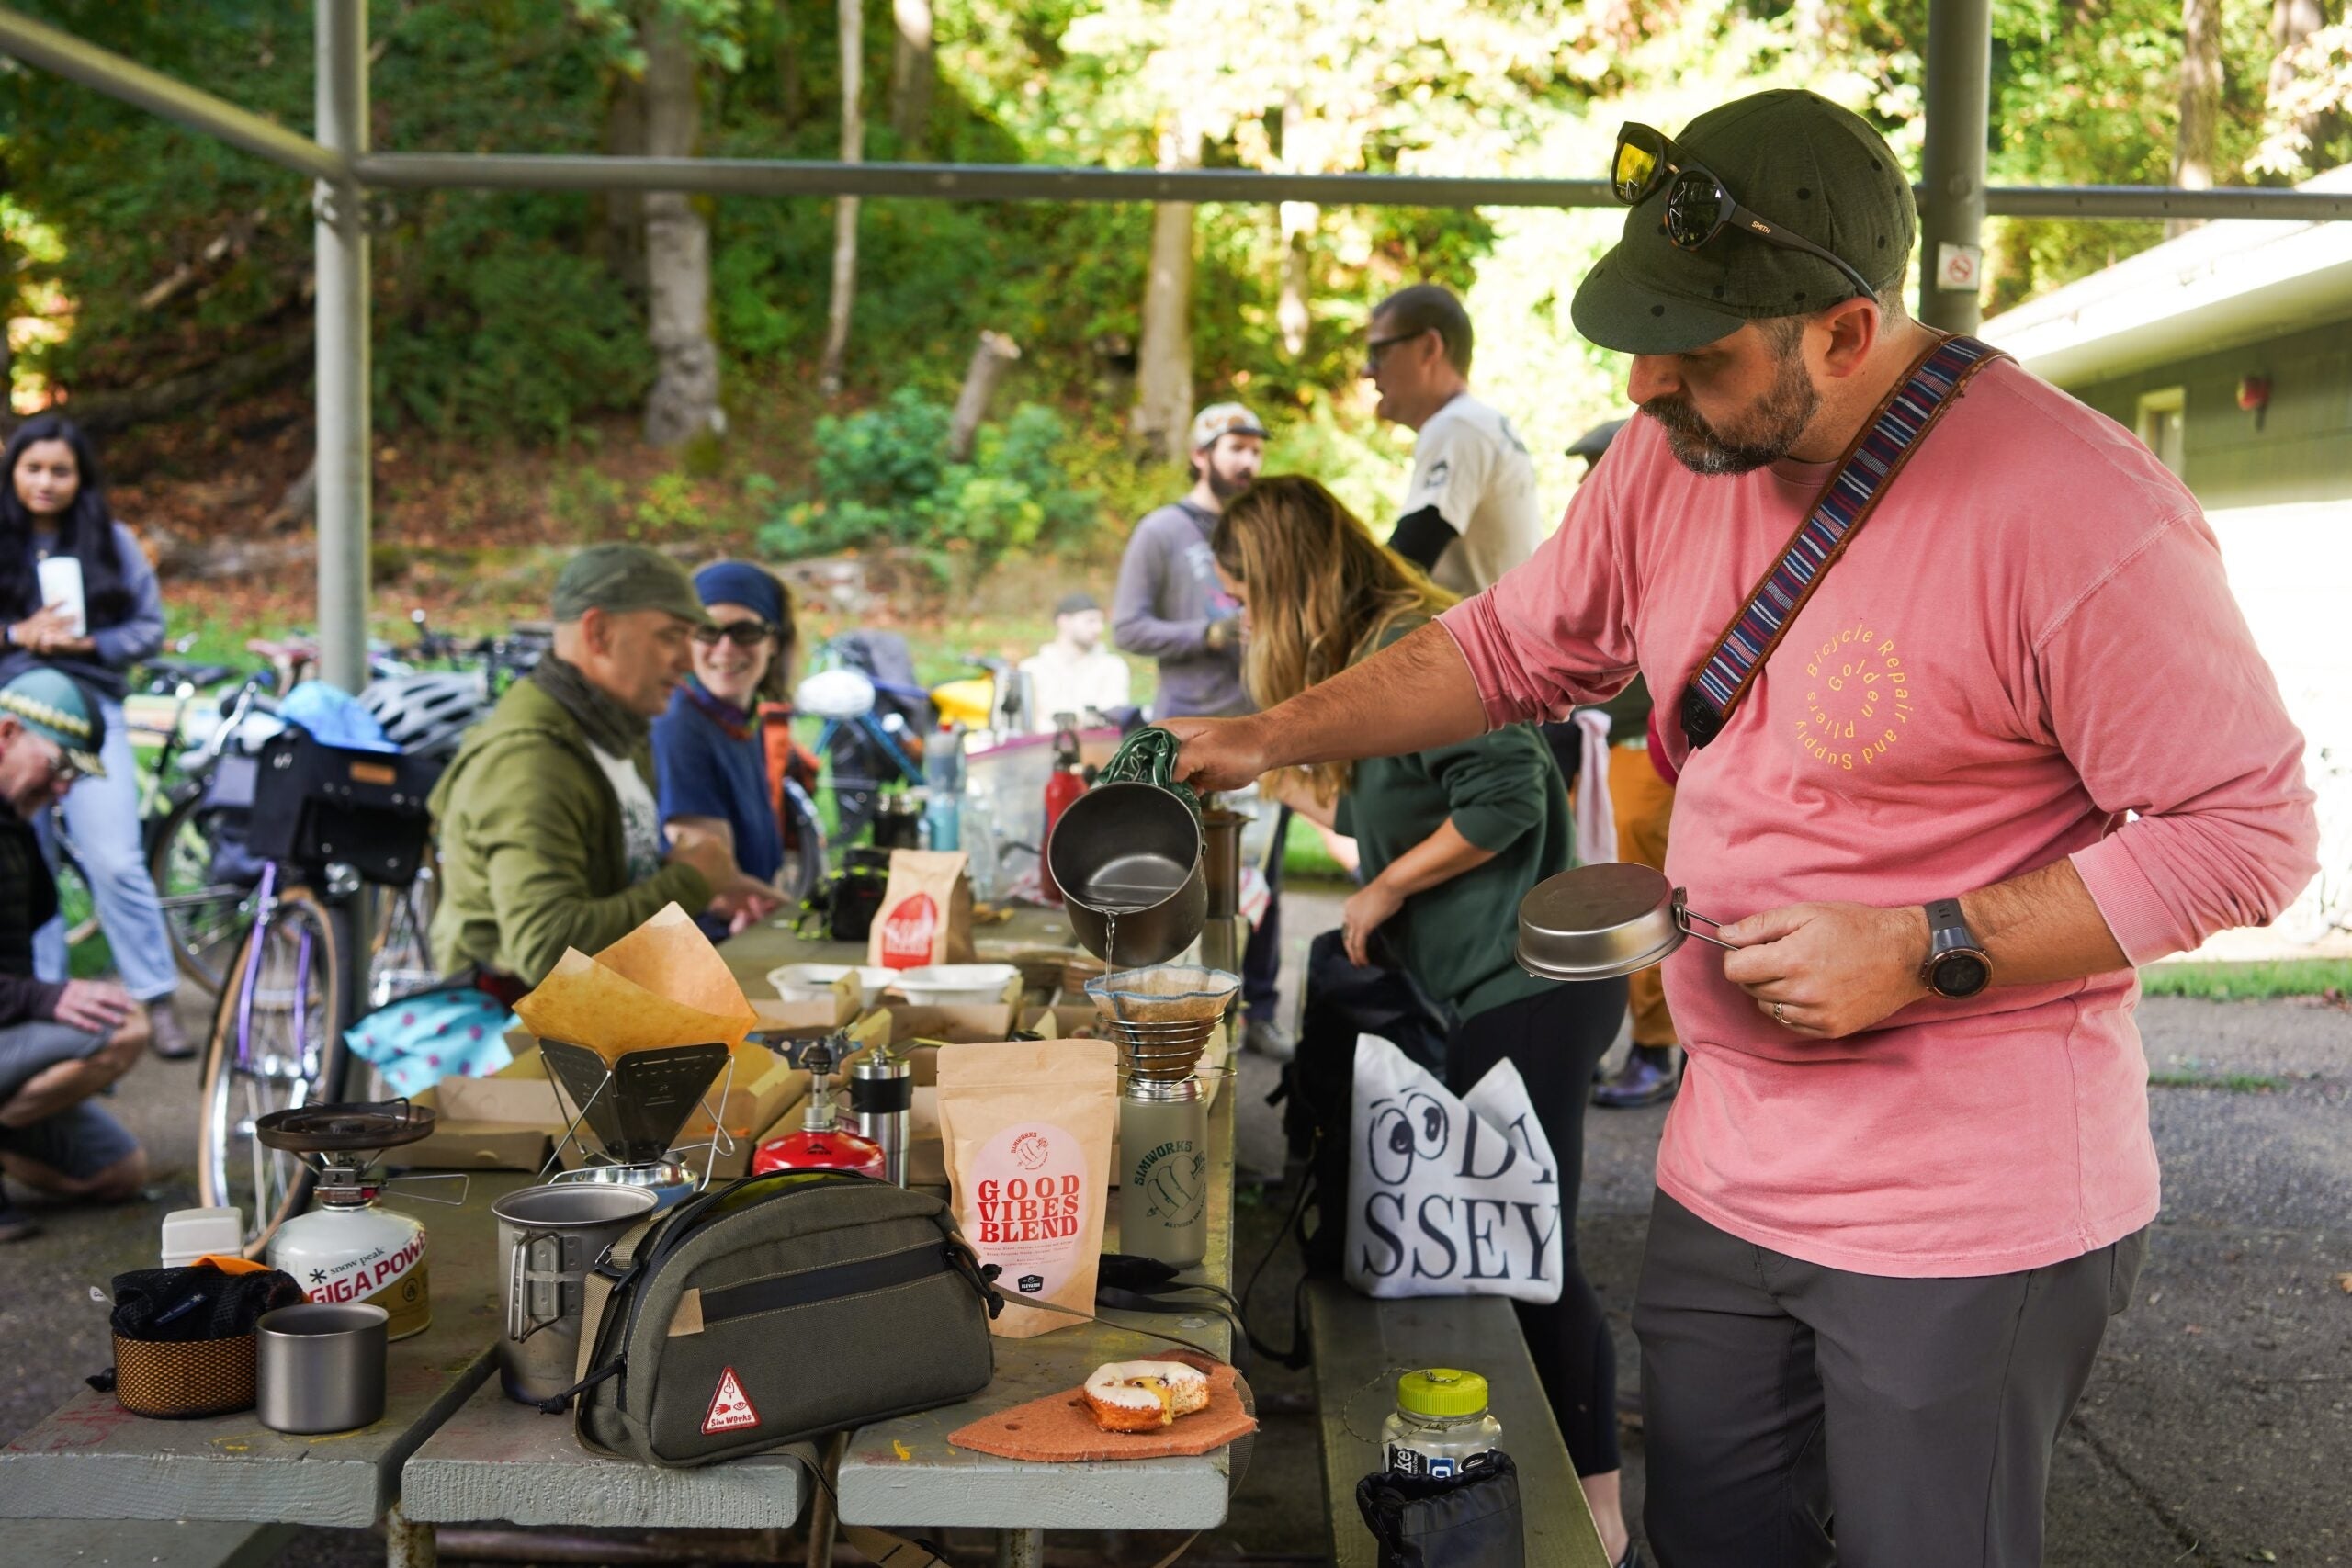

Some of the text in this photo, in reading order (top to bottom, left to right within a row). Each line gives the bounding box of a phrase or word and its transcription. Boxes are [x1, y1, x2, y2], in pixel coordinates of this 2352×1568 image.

[1751, 220, 1771, 234] SMITH
[1795, 624, 1914, 770] Bicycle Repair and Supply
[1807, 659, 1881, 739] Golden Pliers
[1134, 1141, 1193, 1186] SIMWORKS
[978, 1174, 1080, 1201] GOOD
[978, 1194, 1079, 1222] VIBES
[978, 1215, 1078, 1243] BLEND
[1362, 1191, 1560, 1281] SSEY
[330, 1247, 385, 1275] snow peak
[309, 1271, 373, 1303] GIGA
